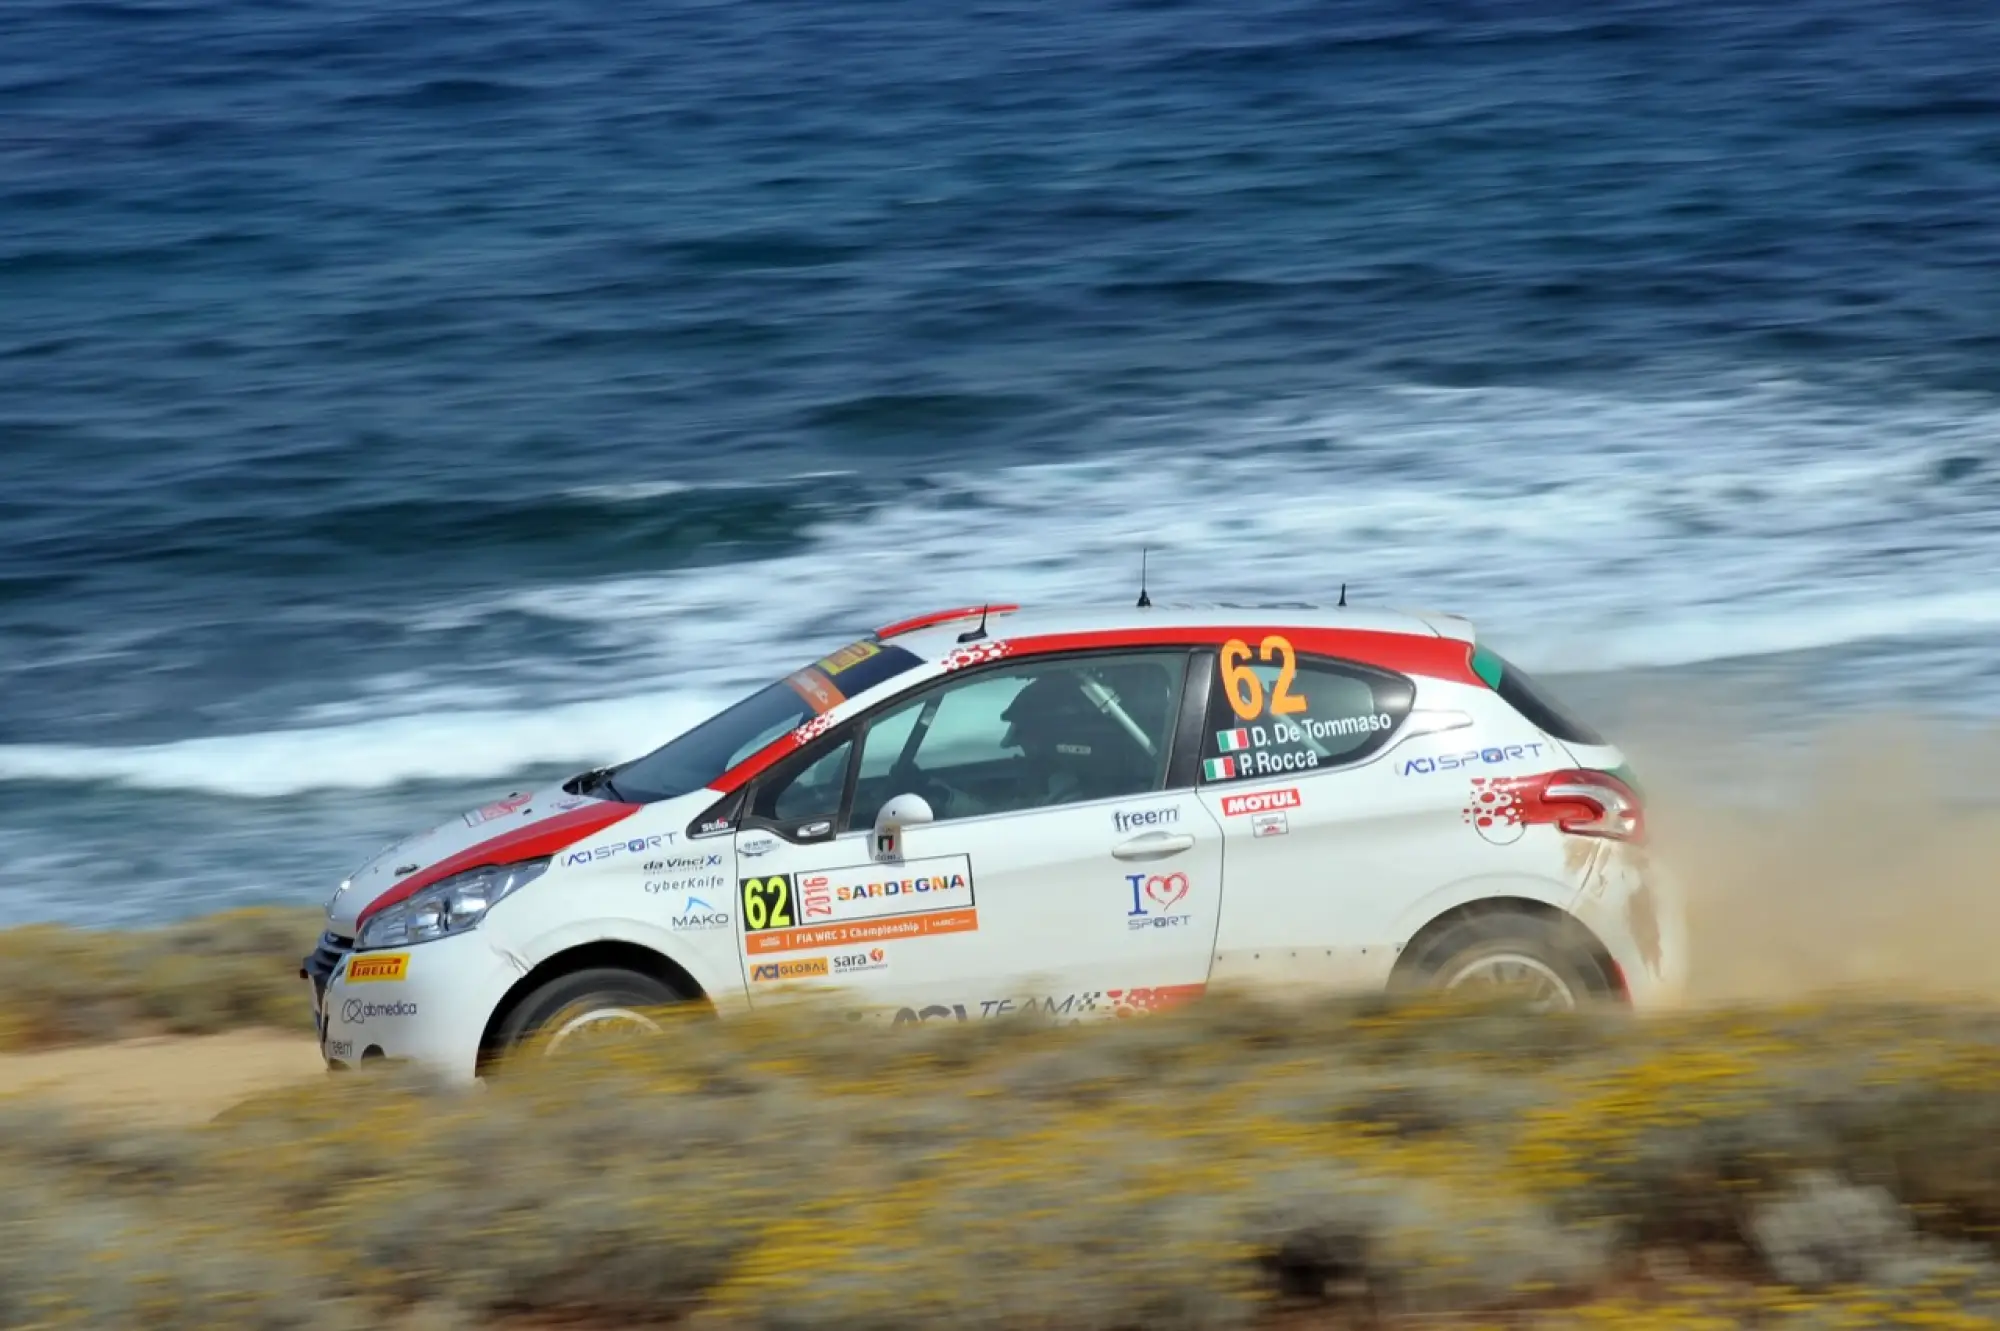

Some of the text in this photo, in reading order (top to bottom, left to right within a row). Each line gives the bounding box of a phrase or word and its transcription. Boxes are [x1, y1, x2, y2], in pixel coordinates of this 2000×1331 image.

[1220, 635, 1307, 720] 62
[1252, 713, 1391, 748] D. De Tommaso
[1239, 750, 1318, 776] P. Rocca
[1228, 791, 1297, 813] MOTUL
[1114, 807, 1178, 832] freem
[644, 875, 724, 894] CyberKnife
[836, 874, 965, 901] SARDEGNA
[1125, 874, 1147, 916] I
[744, 875, 791, 930] 62
[803, 876, 832, 918] 2016
[672, 913, 729, 927] MAKO
[849, 921, 920, 938] Championship
[1128, 915, 1192, 930] SPORT
[350, 958, 402, 978] PIRELLI
[780, 963, 826, 975] GLOBAL
[834, 954, 867, 968] sara
